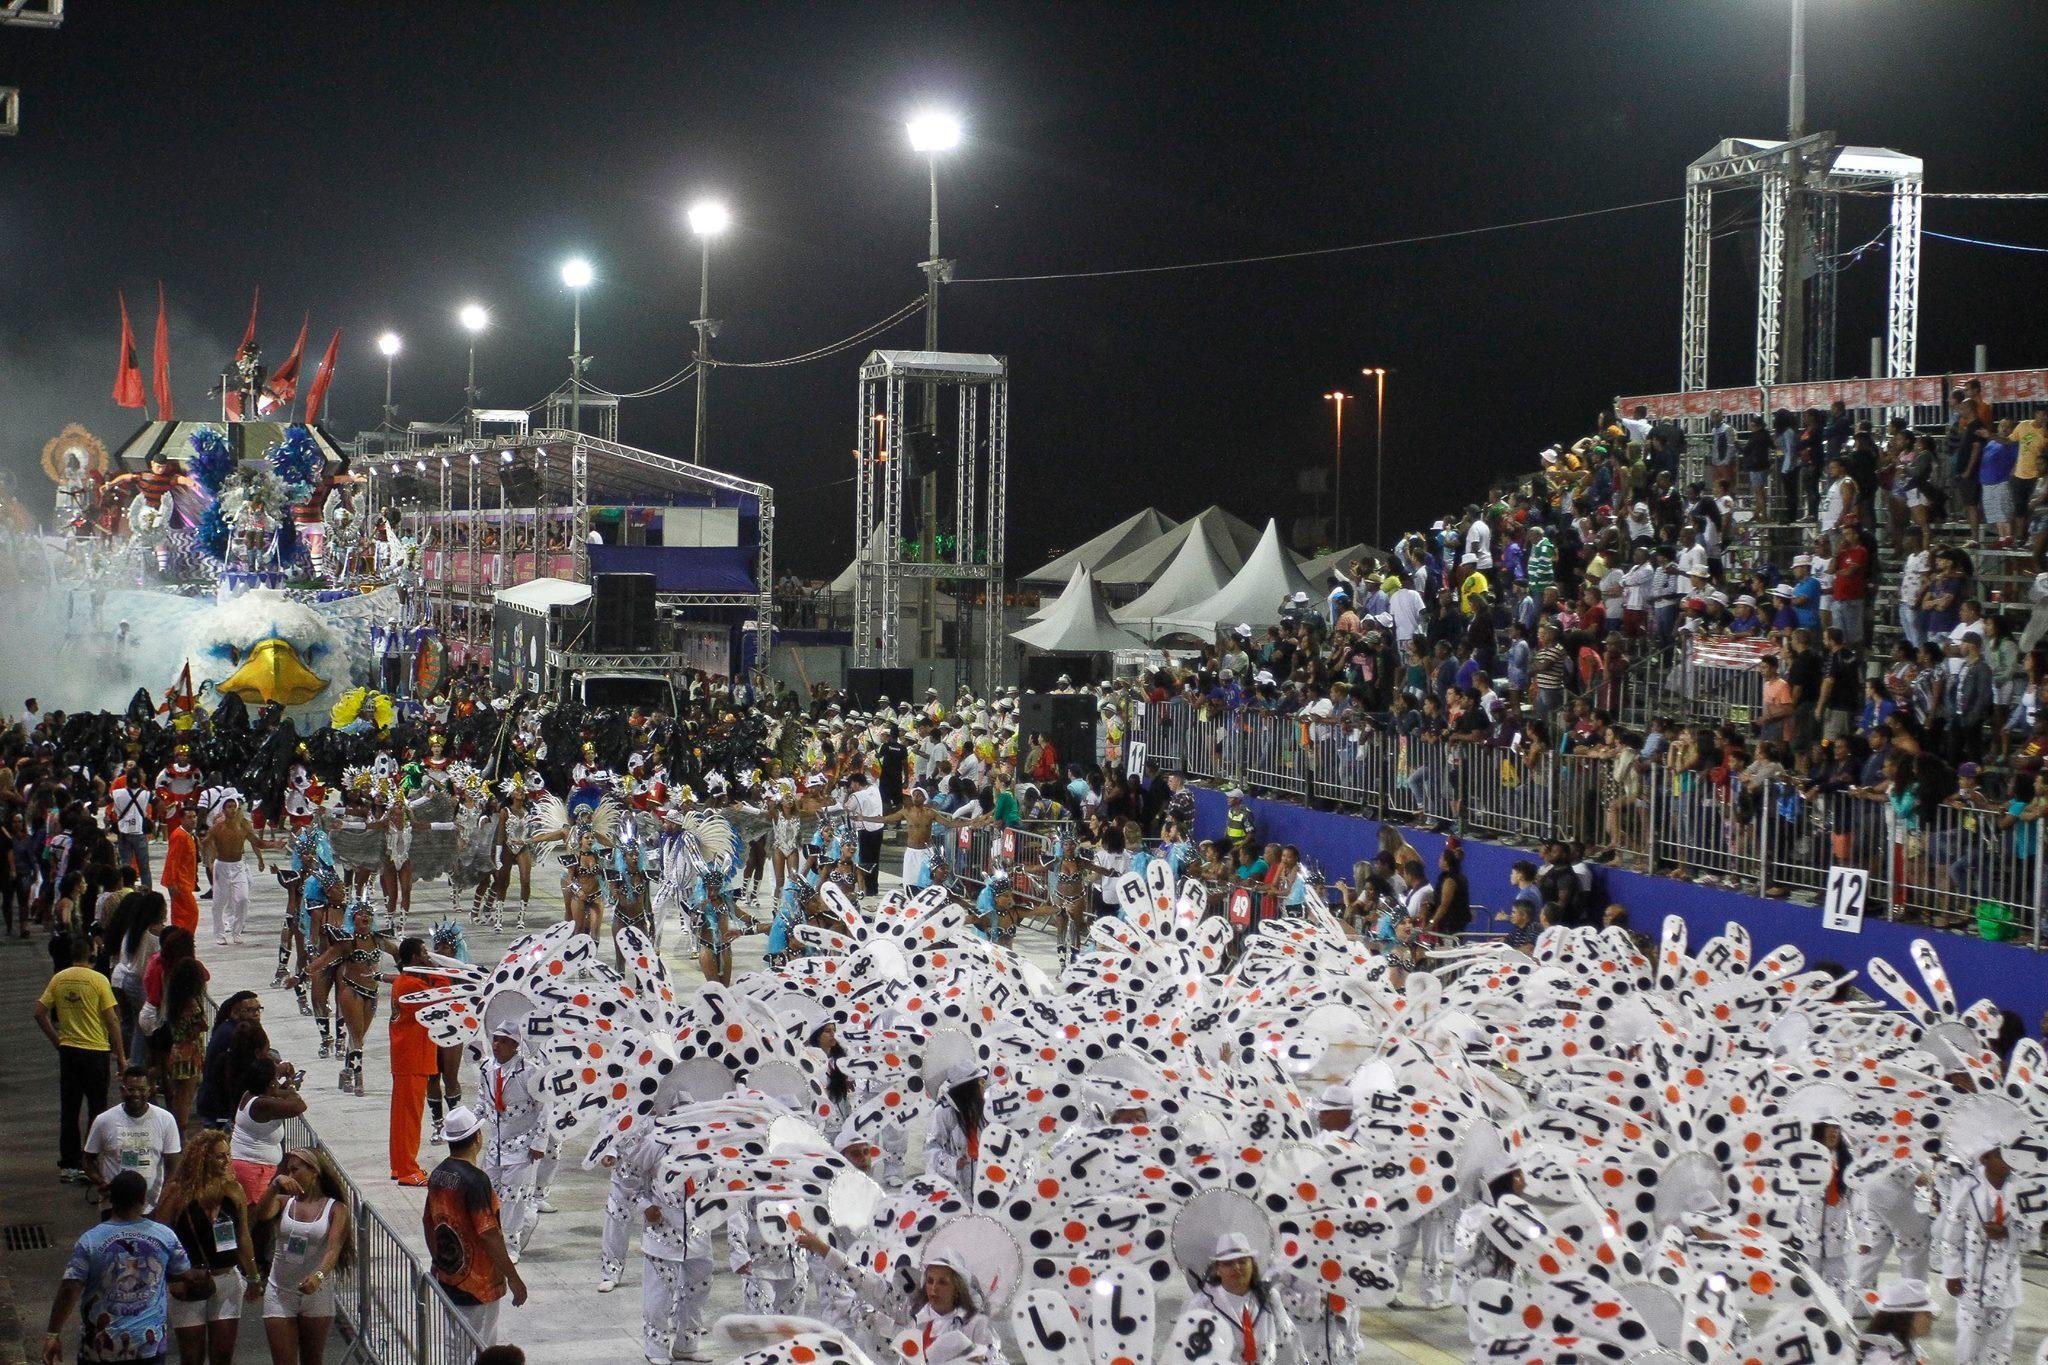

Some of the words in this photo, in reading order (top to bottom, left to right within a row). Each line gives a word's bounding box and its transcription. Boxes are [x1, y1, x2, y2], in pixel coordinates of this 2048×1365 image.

[1131, 744, 1144, 773] 11
[1003, 833, 1013, 852] 46
[1232, 895, 1249, 917] 49
[1833, 872, 1862, 916] 12
